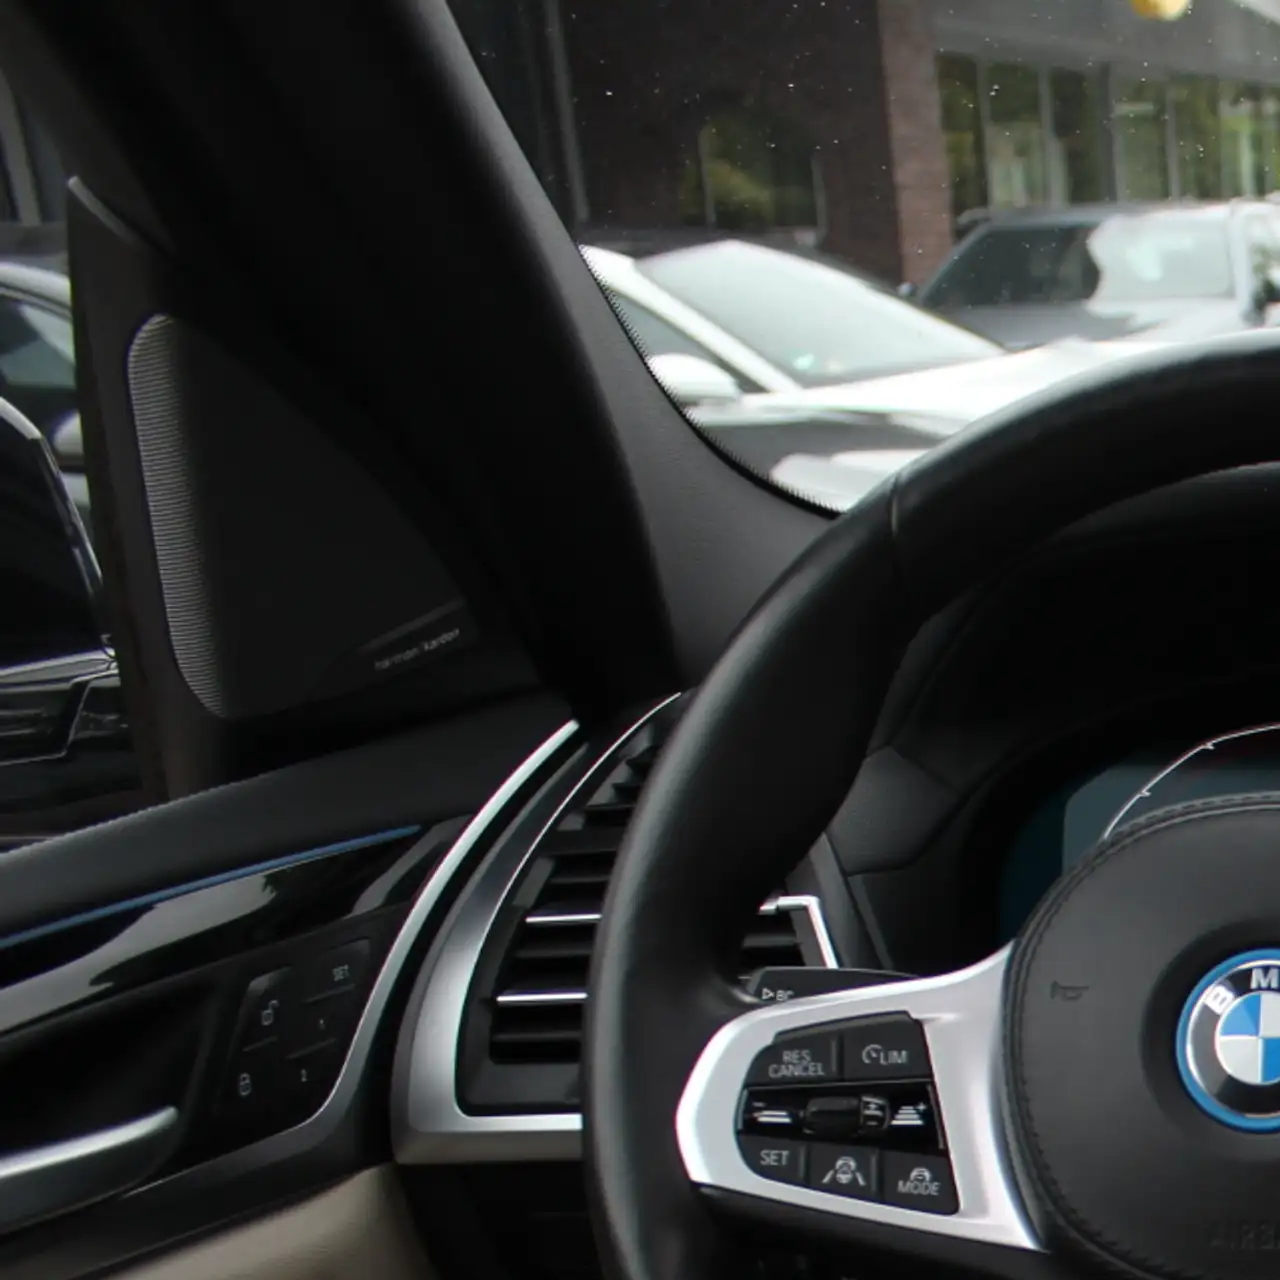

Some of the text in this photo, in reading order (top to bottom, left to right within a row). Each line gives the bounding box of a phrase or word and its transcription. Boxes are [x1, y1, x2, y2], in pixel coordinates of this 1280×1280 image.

[782, 1049, 811, 1063] RES
[879, 1050, 908, 1065] LIM
[768, 1062, 825, 1078] CANCEL
[760, 1150, 789, 1166] SET
[897, 1180, 940, 1196] MODE
